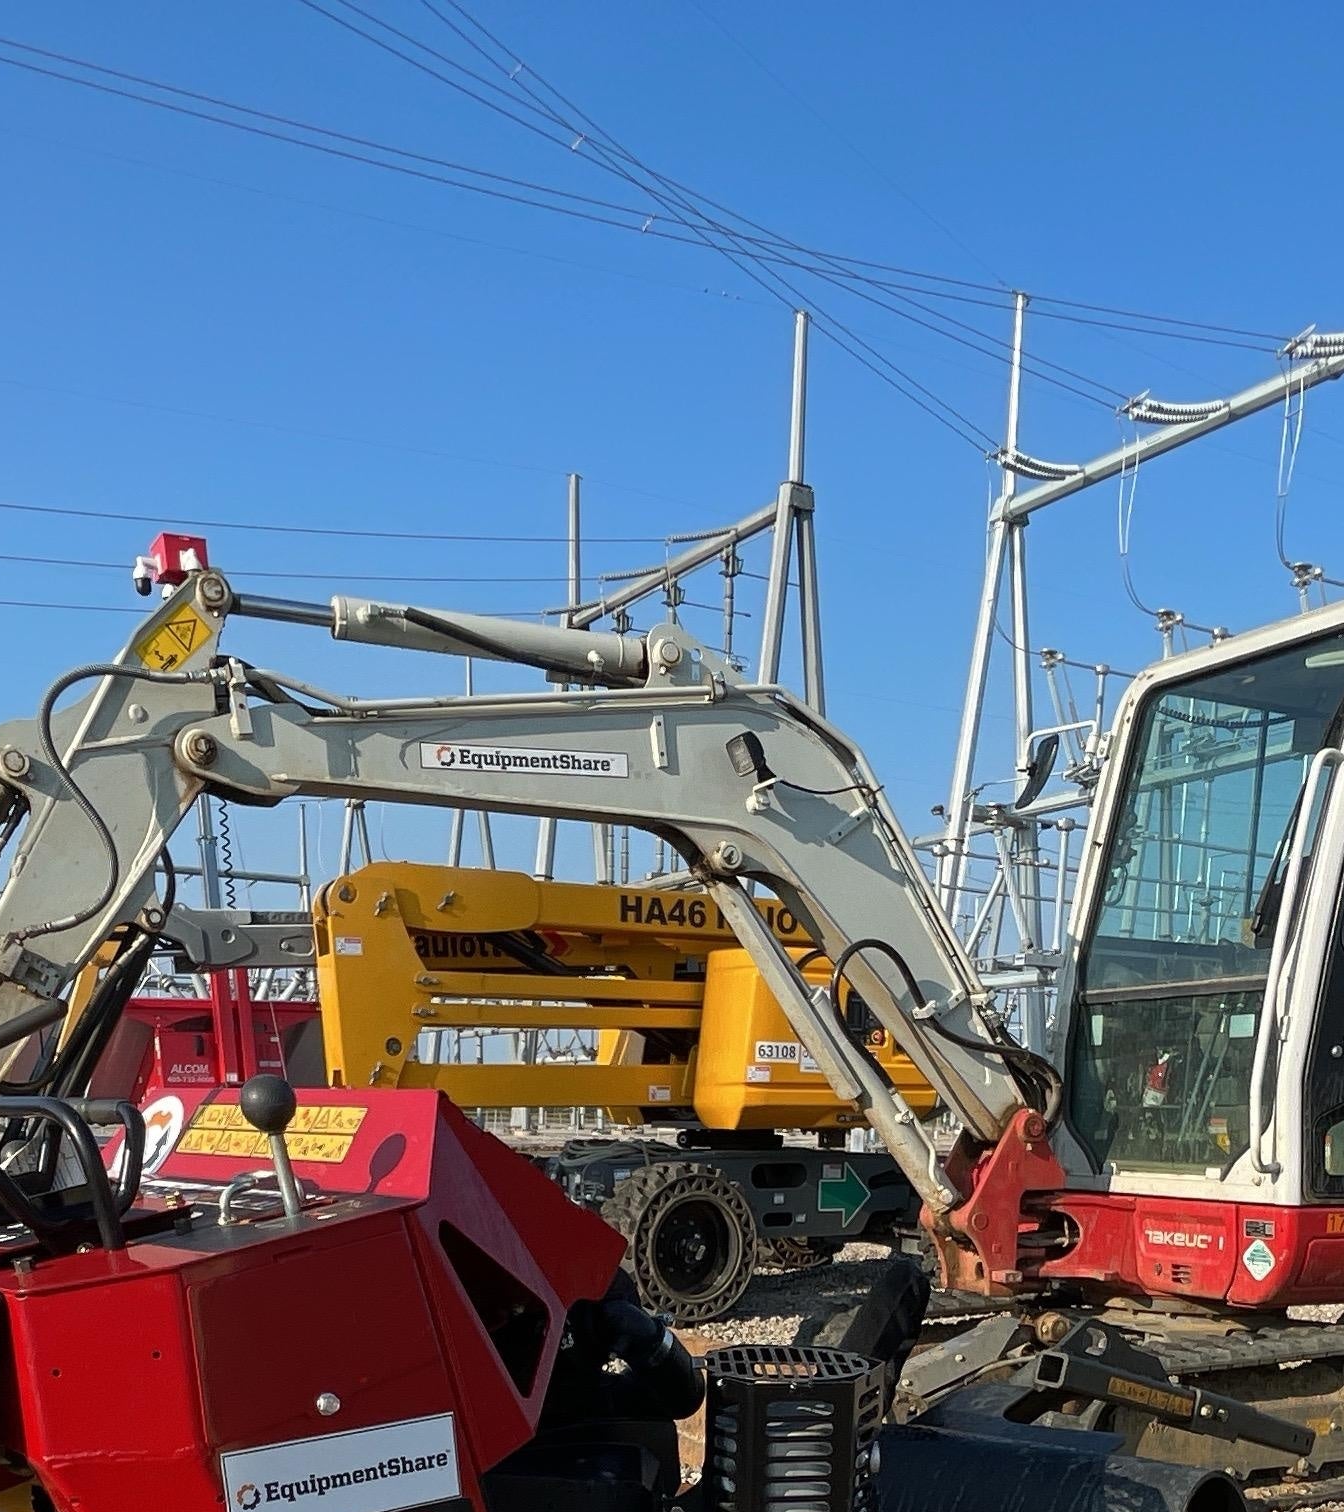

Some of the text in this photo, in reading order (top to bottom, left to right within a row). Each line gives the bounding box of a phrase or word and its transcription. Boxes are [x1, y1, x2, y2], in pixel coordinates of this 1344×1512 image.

[458, 748, 612, 771] EquipmentShare
[620, 895, 707, 928] HA46
[758, 1044, 796, 1058] 63108
[170, 1063, 210, 1074] ALCOM
[265, 1452, 448, 1503] EquipmentShare
